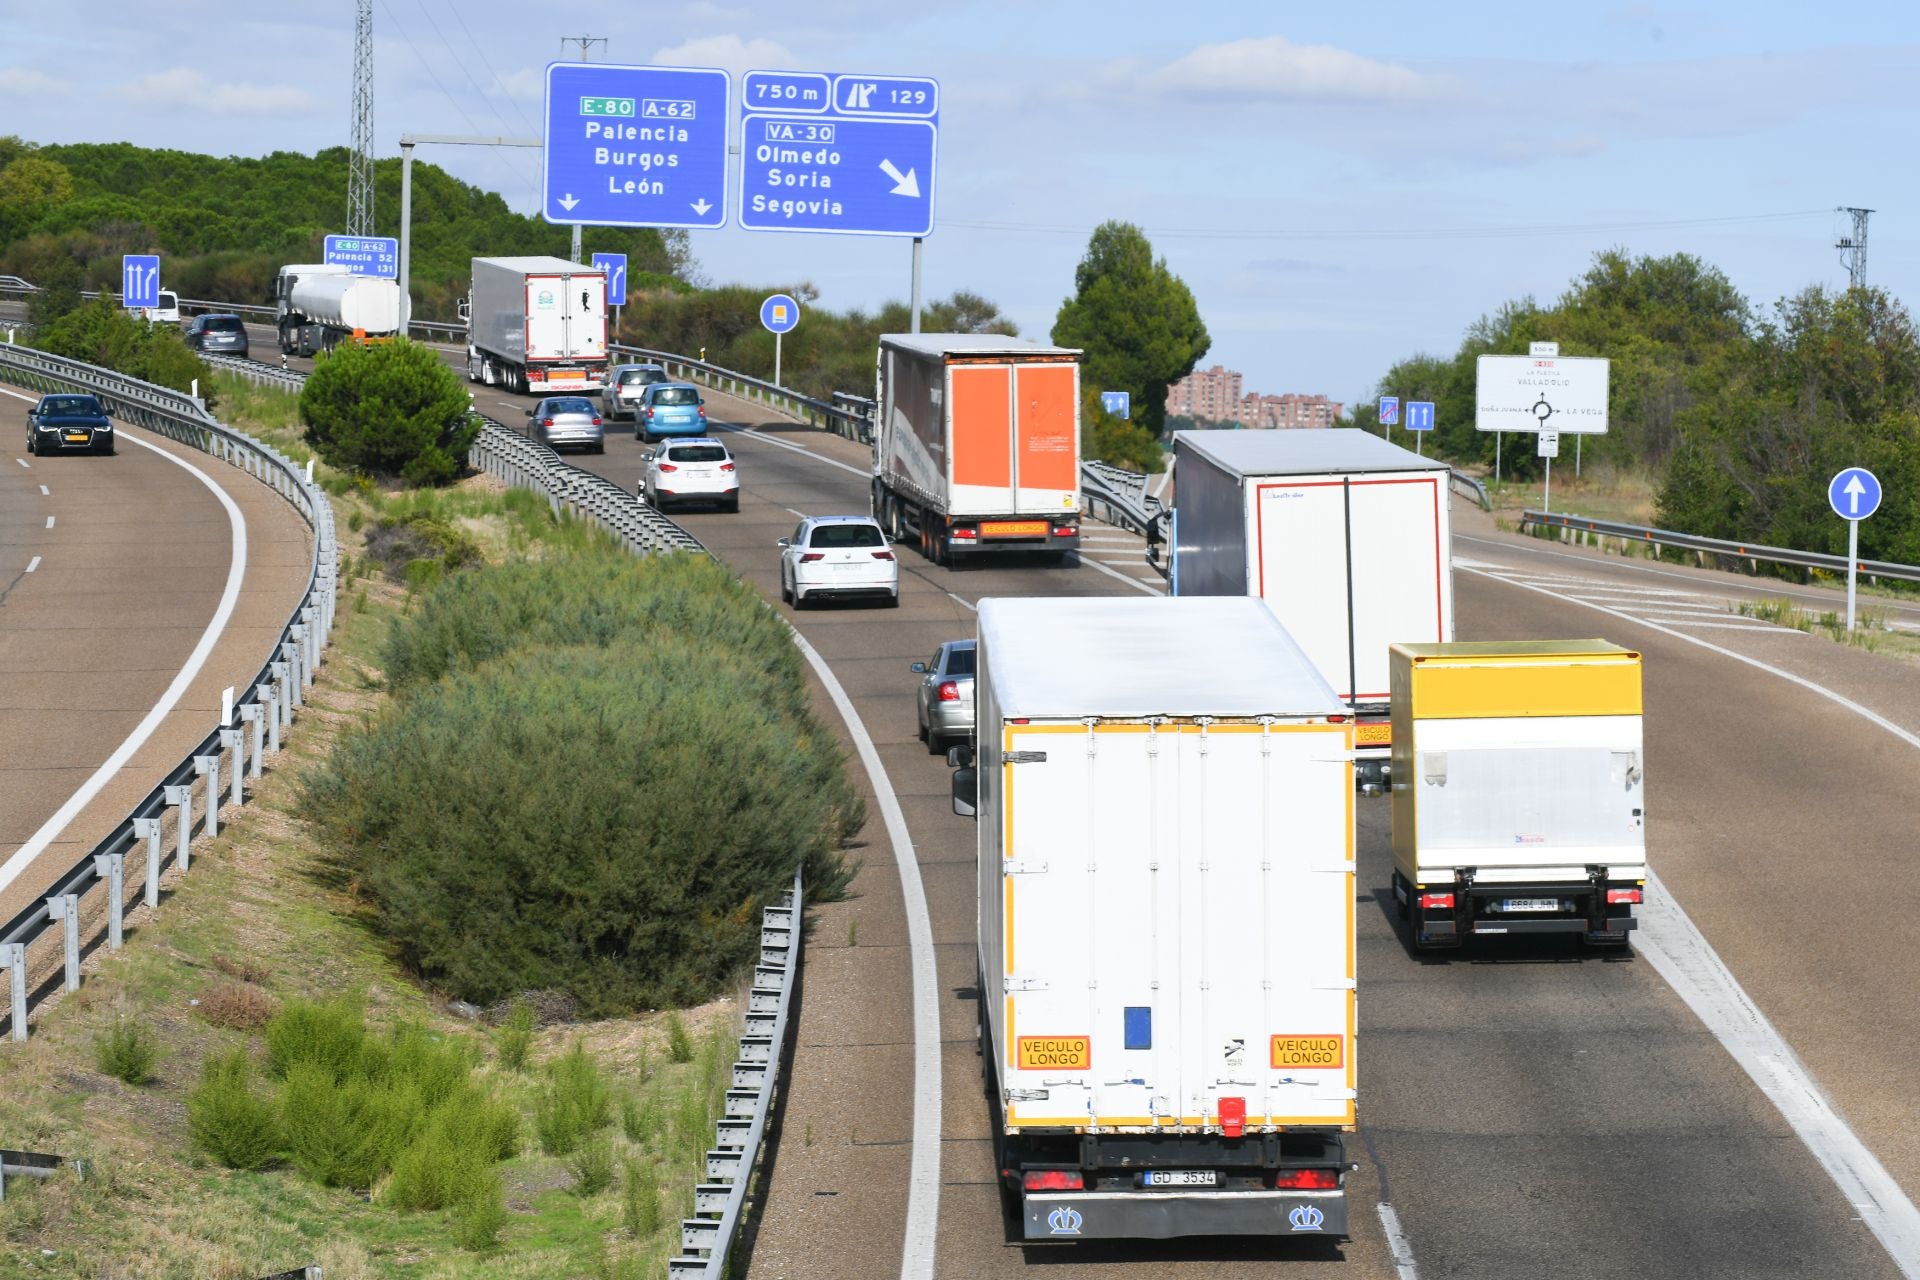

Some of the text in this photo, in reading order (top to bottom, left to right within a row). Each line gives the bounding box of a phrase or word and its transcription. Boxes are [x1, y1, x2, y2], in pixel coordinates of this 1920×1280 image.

[755, 84, 818, 100] 750 m
[890, 90, 926, 104] 129
[583, 99, 693, 117] E-80 A-62
[586, 121, 688, 142] Palencia
[768, 125, 832, 141] VA-30
[595, 147, 679, 172] Burgos
[756, 145, 841, 165] Olmedo
[767, 168, 831, 188] Soria
[609, 176, 664, 195] León
[752, 194, 843, 219] Segovia
[336, 241, 384, 251] E-80 A-62
[328, 252, 393, 262] Palencia 52
[377, 265, 393, 273] 131
[1517, 378, 1570, 386] VALLADOLID
[1017, 524, 1044, 532] LONGO
[1023, 1041, 1084, 1052] VEICULO
[1277, 1040, 1338, 1051] VEICULO
[1029, 1053, 1079, 1065] LONGO
[1282, 1052, 1332, 1064] LONGO
